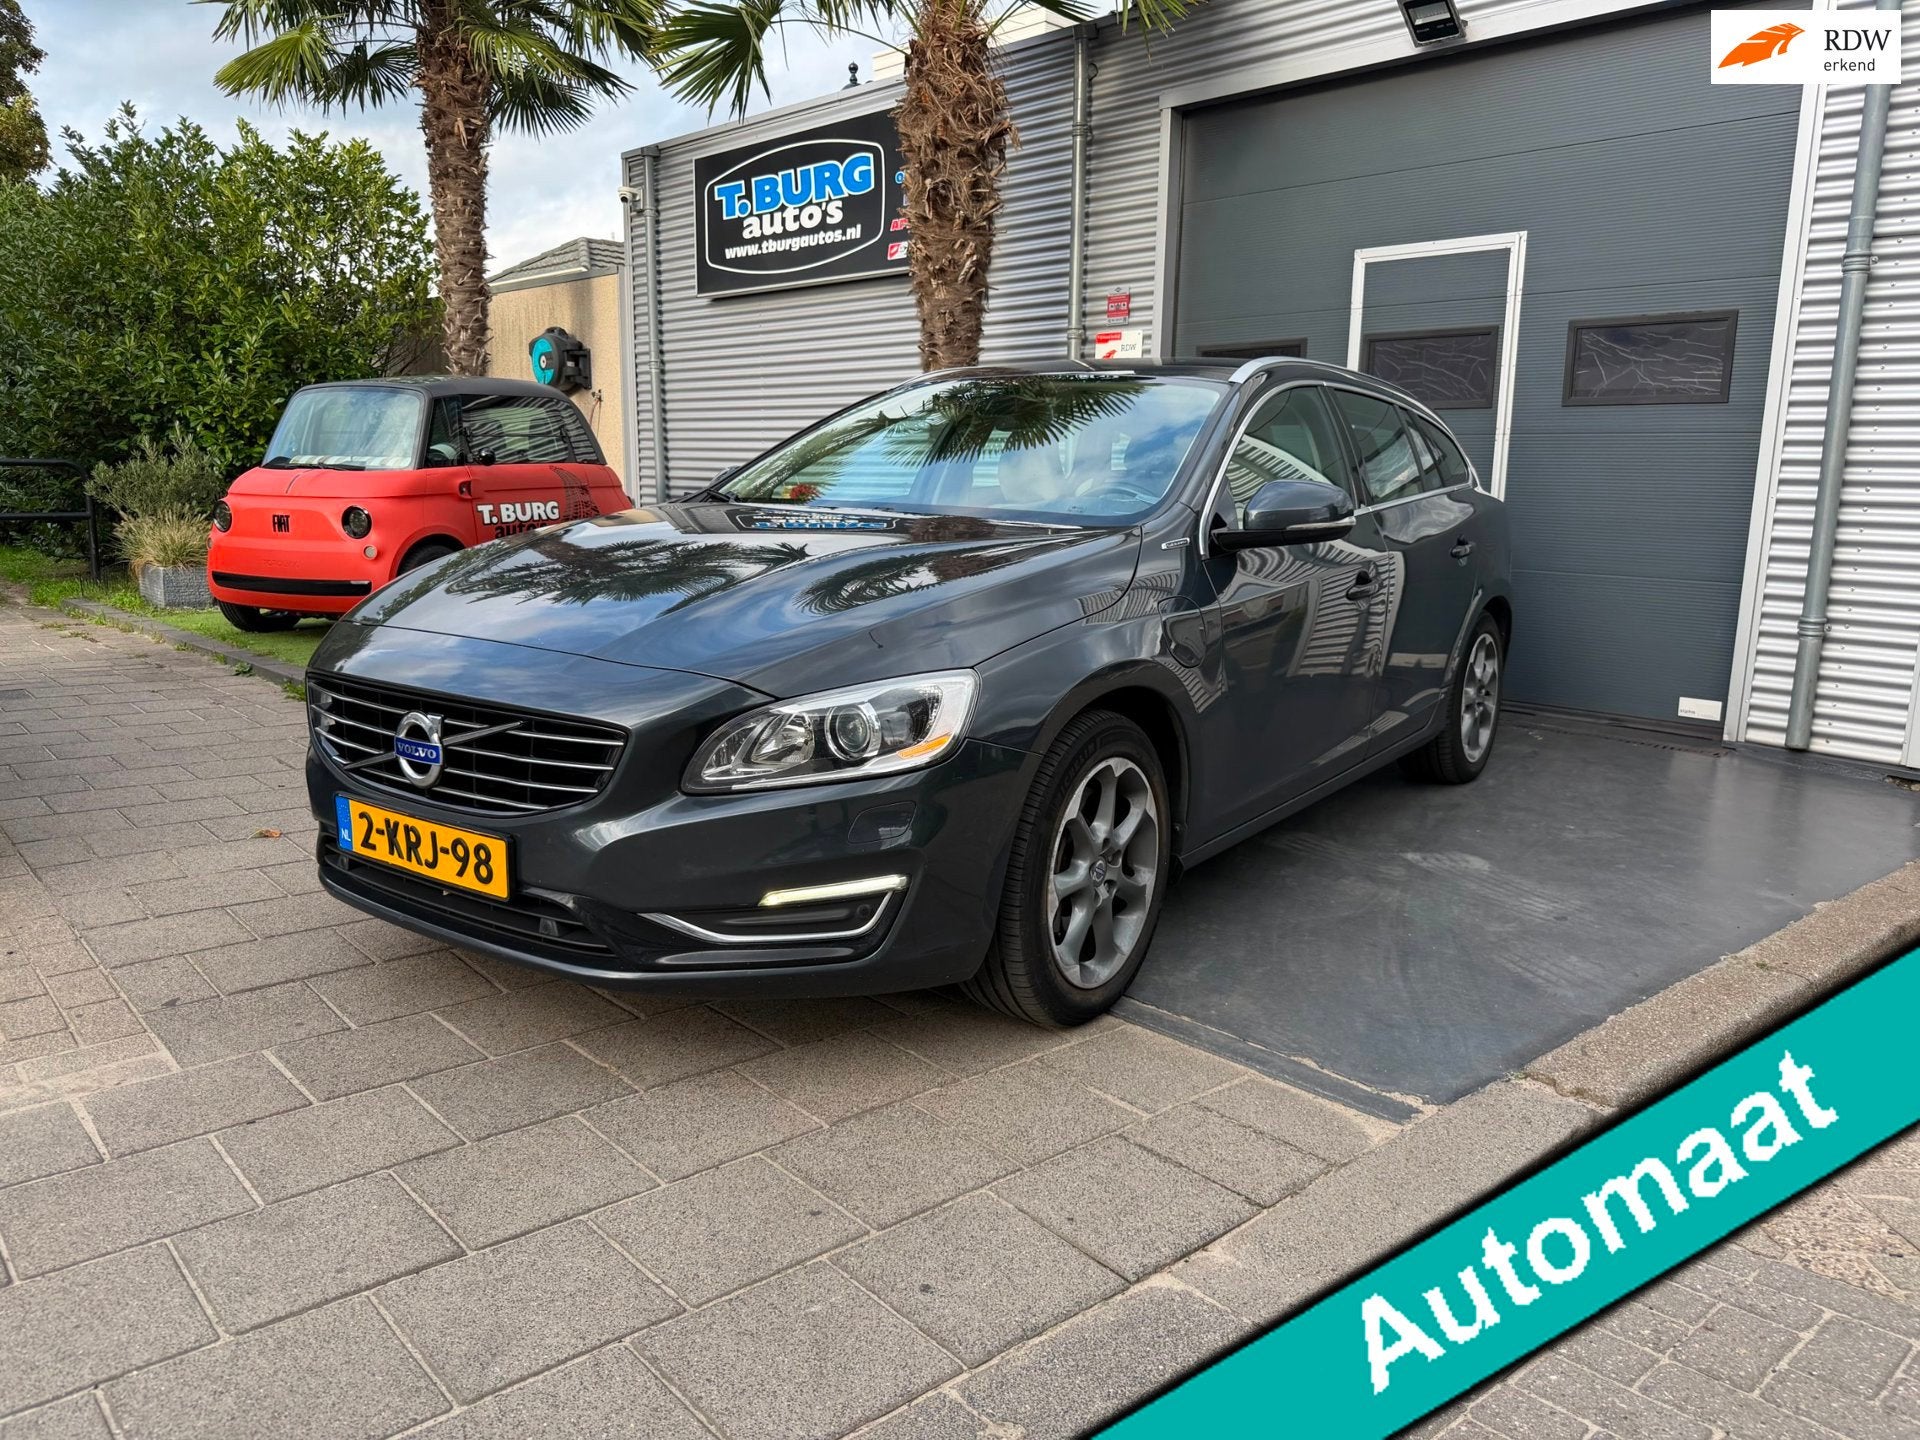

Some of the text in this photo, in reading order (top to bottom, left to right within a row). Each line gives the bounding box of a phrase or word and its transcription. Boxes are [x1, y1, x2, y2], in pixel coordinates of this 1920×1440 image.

[714, 152, 875, 220] T.BURG
[742, 200, 843, 240] auto's
[725, 224, 862, 260] www.tburgautos.nl
[272, 514, 290, 533] FIAT
[397, 741, 437, 759] VOLVO
[341, 828, 351, 842] NL
[358, 811, 494, 885] 2-KRJ-98
